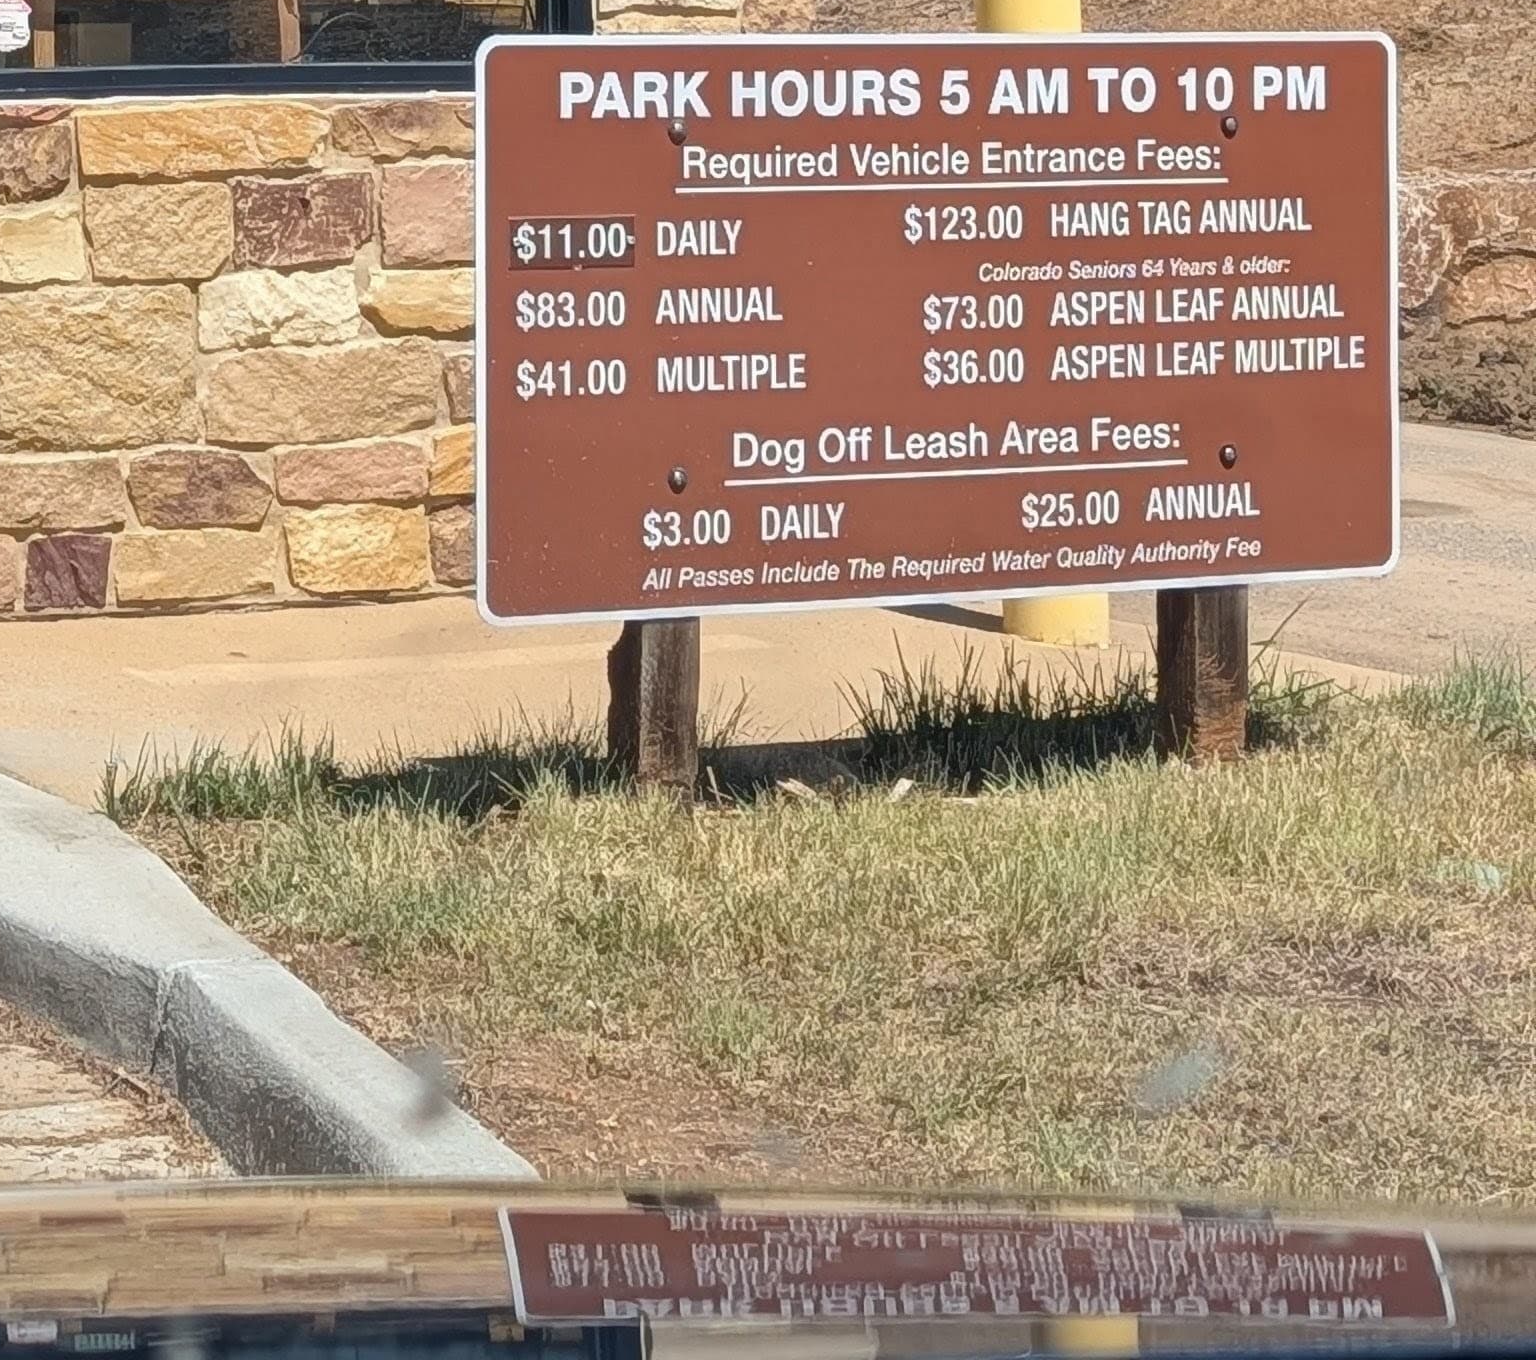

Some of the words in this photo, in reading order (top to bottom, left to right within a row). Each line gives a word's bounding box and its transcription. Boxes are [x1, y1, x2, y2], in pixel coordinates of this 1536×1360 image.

[560, 72, 711, 118] PARK
[732, 69, 921, 117] HOURS
[940, 70, 970, 114] 5
[988, 68, 1068, 114] AM
[1088, 68, 1156, 112] TO
[1178, 68, 1233, 111] 10
[1254, 66, 1325, 110] PM
[684, 144, 837, 185] Required
[850, 143, 969, 176] Vehicle
[982, 142, 1125, 174] Entrance
[1138, 139, 1220, 170] Fees:
[517, 222, 626, 264] $11.00
[657, 220, 742, 256] DAILY
[904, 204, 1022, 244] $123.00
[1052, 202, 1129, 236] HANG
[1138, 200, 1191, 234] TAG
[1199, 198, 1312, 233] ANNUAL
[979, 262, 1063, 282] Colorado
[1068, 260, 1136, 279] Seniors
[1170, 258, 1217, 276] Years
[1222, 256, 1234, 275] &
[516, 290, 625, 332] $83.00
[656, 287, 783, 324] ANNUAL
[924, 294, 1023, 334] $73.00
[1051, 290, 1144, 326] ASPEN
[1156, 288, 1224, 322] LEAF
[1232, 284, 1344, 320] ANNUAL
[517, 359, 626, 401] $41.00
[658, 354, 806, 392] MULTIPLE
[924, 348, 1024, 388] $36.00
[1051, 344, 1144, 380] ASPEN
[1157, 341, 1224, 376] LEAF
[1236, 336, 1365, 373] MULTIPLE
[734, 433, 804, 473] Dog
[819, 427, 872, 462] Off
[885, 423, 988, 460] Leash
[1000, 421, 1079, 455] Area
[1092, 417, 1179, 451] Fees:
[643, 509, 730, 550] $3.00
[762, 503, 844, 540] DAILY
[1022, 490, 1119, 532] $25.00
[1146, 482, 1260, 521] ANNUAL
[642, 567, 673, 590] All
[678, 567, 754, 588] Passes
[761, 560, 840, 585] Include
[848, 558, 886, 580] The
[891, 552, 985, 581] Required
[992, 550, 1051, 571] Water
[1057, 544, 1125, 569] Quality
[1131, 538, 1221, 564] Authority
[1226, 537, 1261, 557] Fee
